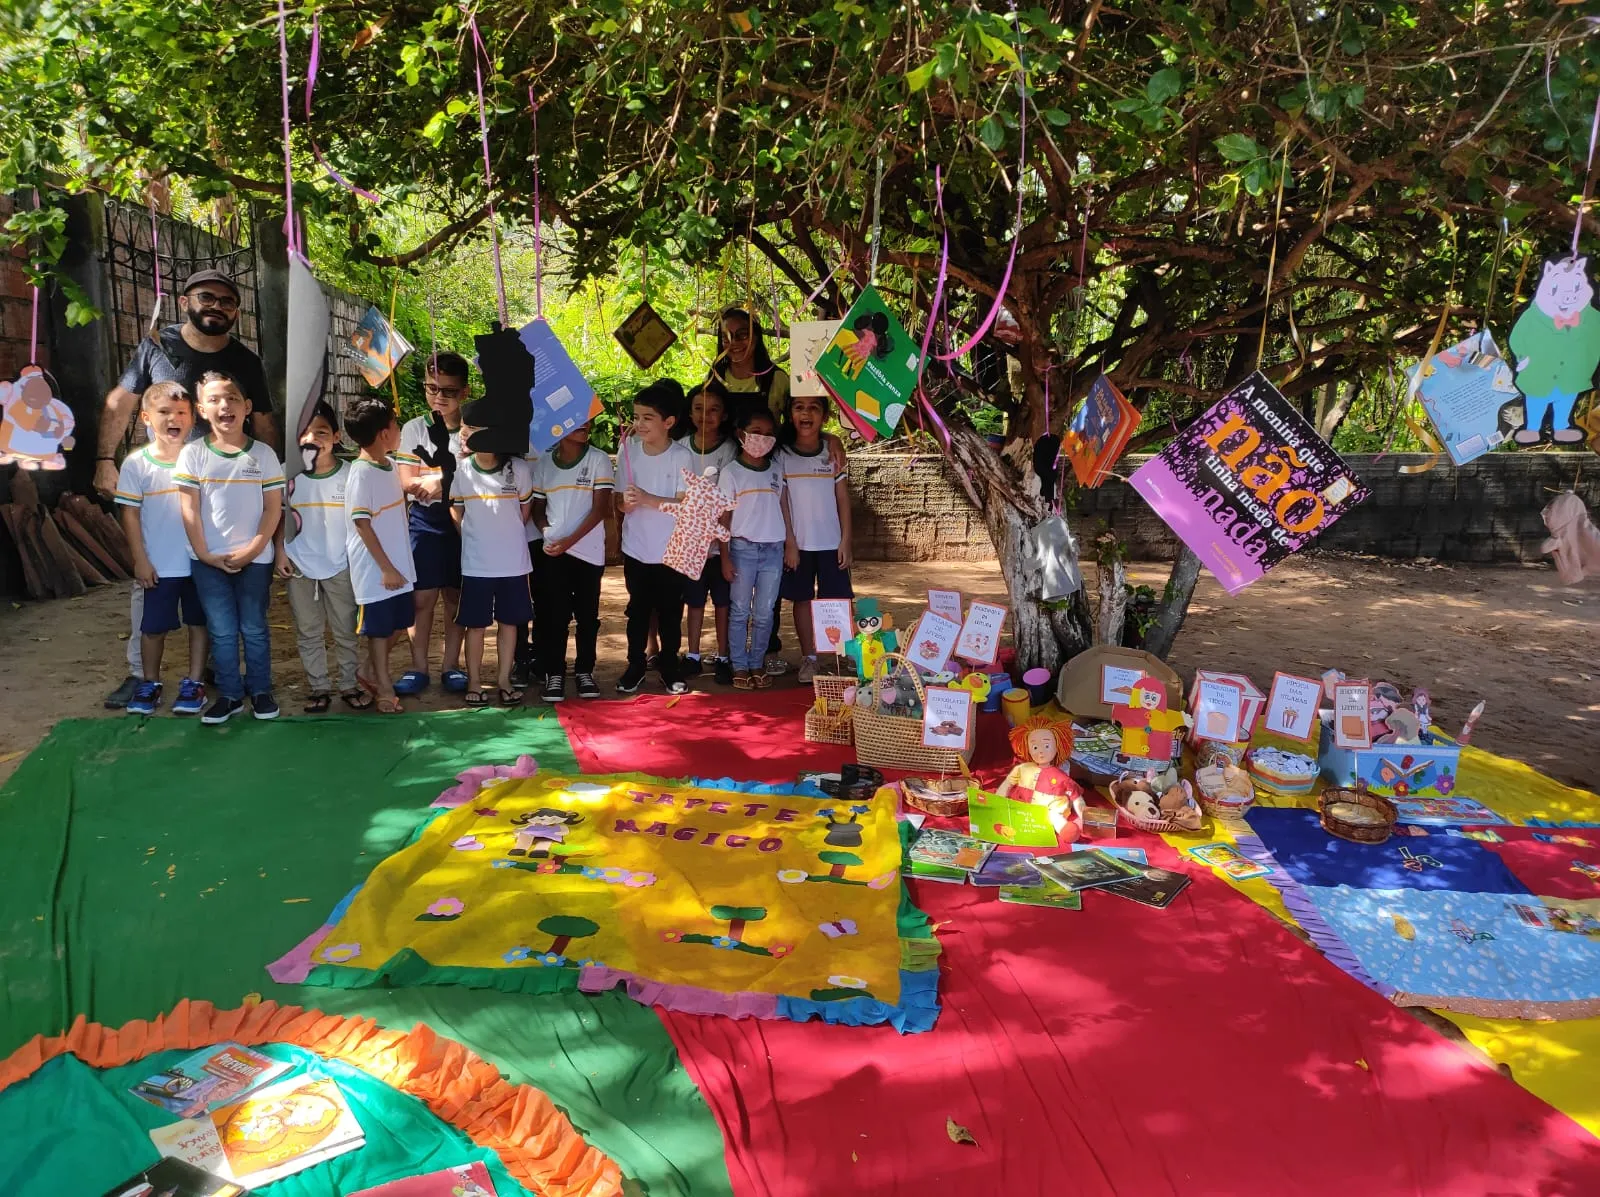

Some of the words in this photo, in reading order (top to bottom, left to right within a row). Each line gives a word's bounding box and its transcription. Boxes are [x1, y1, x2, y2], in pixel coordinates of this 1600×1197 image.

[1240, 383, 1256, 400] A
[1251, 397, 1302, 449] menina
[1296, 446, 1327, 475] que
[1202, 410, 1326, 534] não
[1204, 453, 1239, 494] tinha
[1236, 491, 1274, 529] medo
[1271, 525, 1290, 547] de
[1200, 485, 1268, 558] nada
[612, 818, 784, 853] MAGICO
[627, 790, 802, 823] TAPETE
